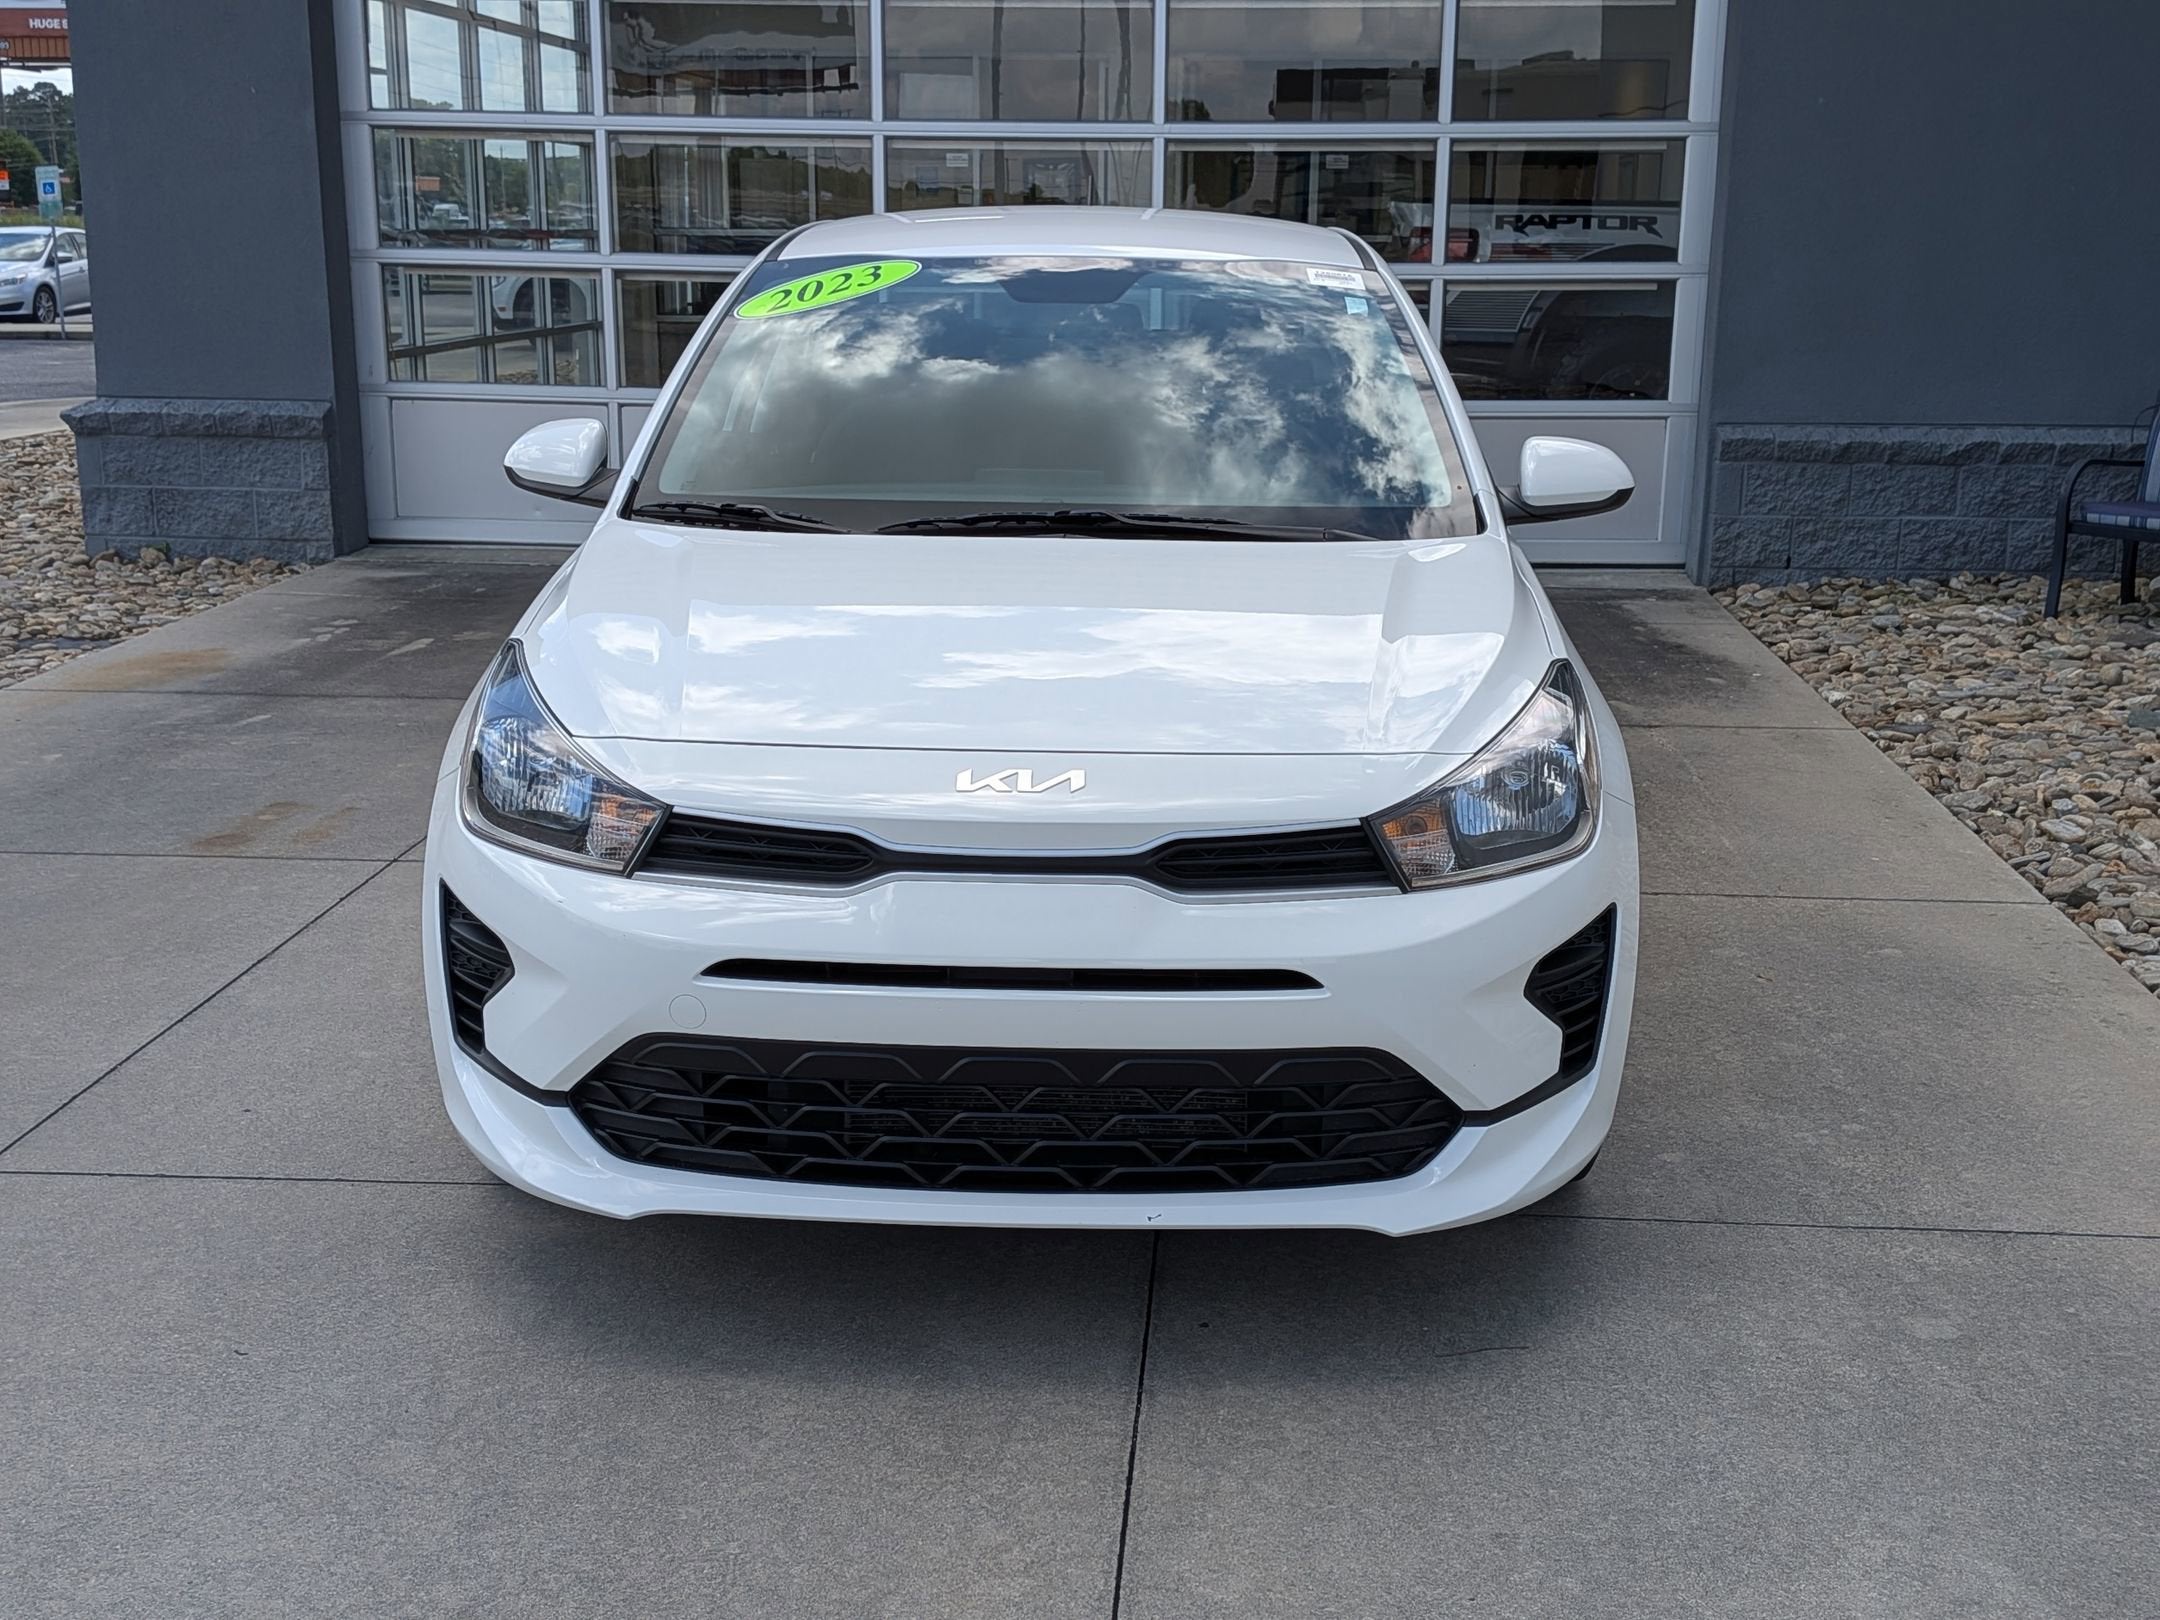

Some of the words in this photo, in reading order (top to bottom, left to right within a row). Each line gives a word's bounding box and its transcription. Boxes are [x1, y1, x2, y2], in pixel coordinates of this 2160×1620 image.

[28, 17, 61, 30] HUGE
[1495, 214, 1663, 239] RAPTOR
[766, 265, 882, 313] 2023
[956, 768, 1086, 793] KIA
